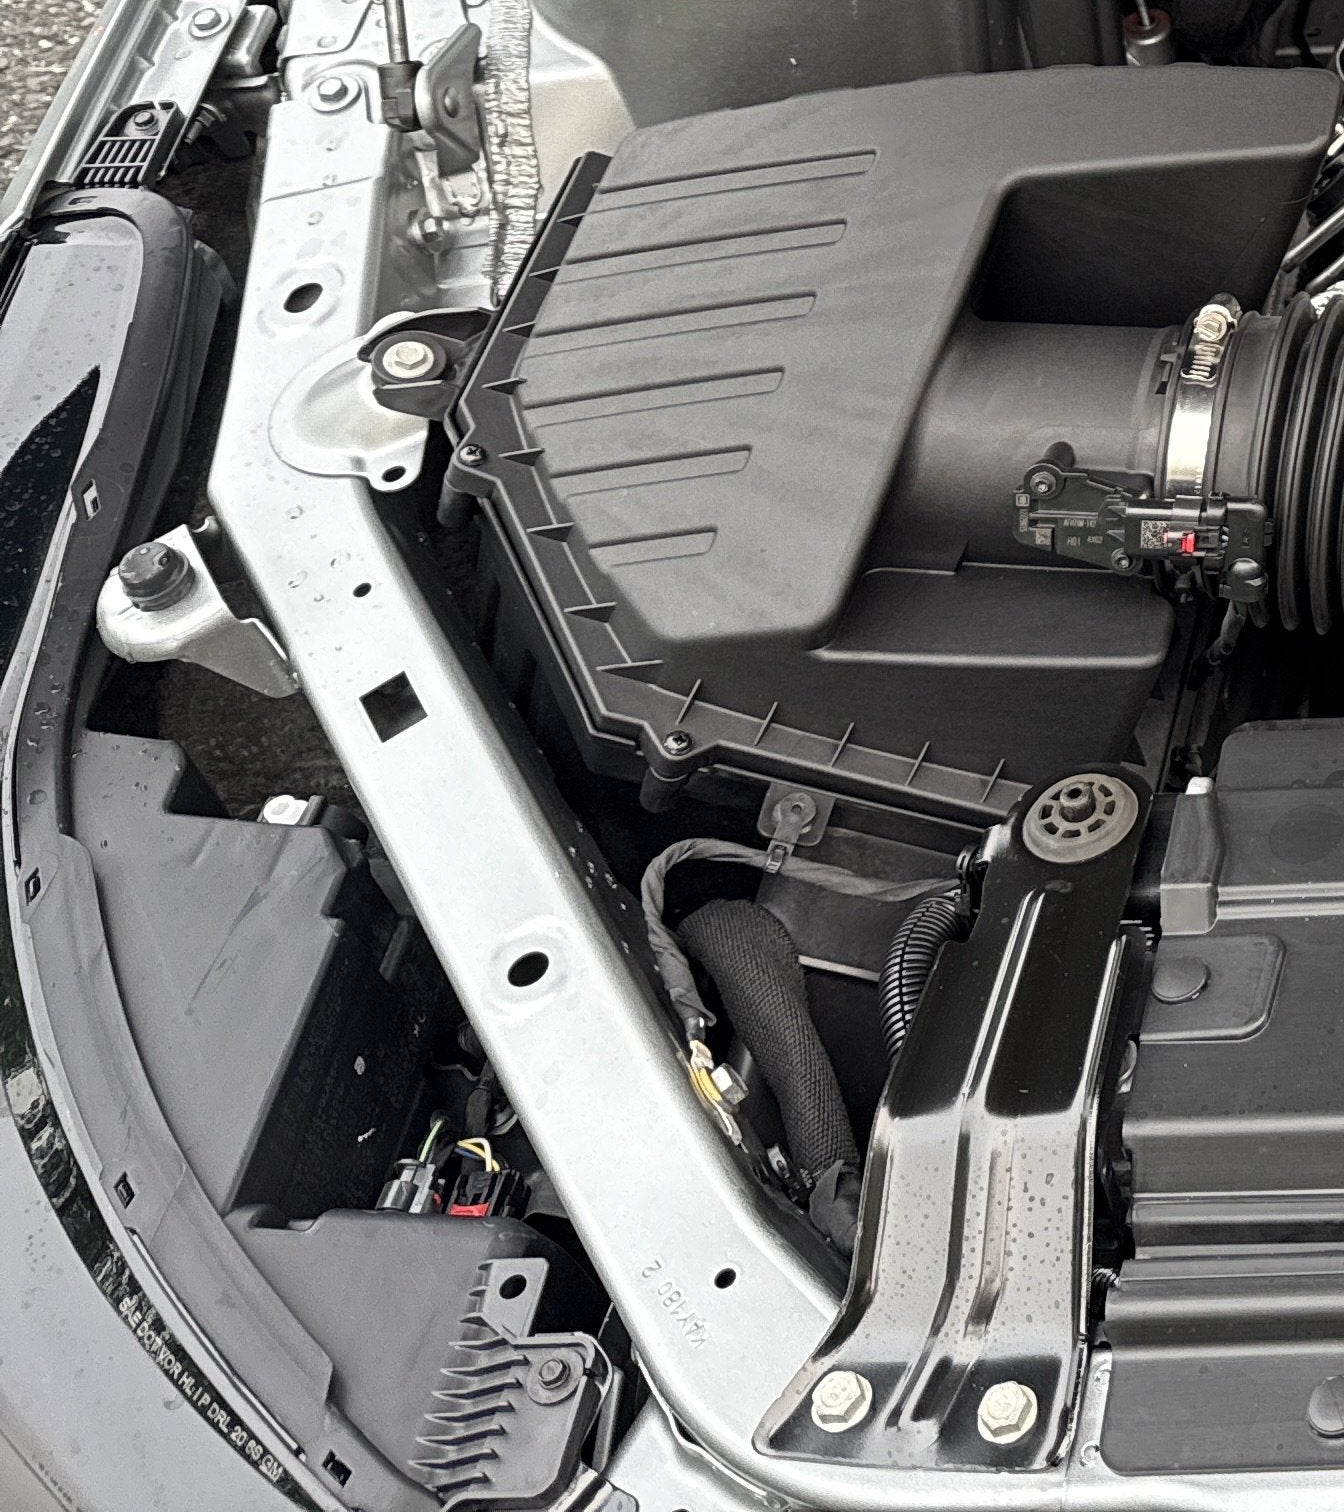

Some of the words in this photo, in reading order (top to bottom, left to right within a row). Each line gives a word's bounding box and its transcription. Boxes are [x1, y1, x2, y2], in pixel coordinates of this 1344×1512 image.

[641, 1259, 663, 1279] 2
[118, 1296, 143, 1329] SAE
[178, 1374, 195, 1397] HL
[197, 1392, 211, 1410] P
[207, 1404, 231, 1434] DRL
[230, 1426, 248, 1446] 20
